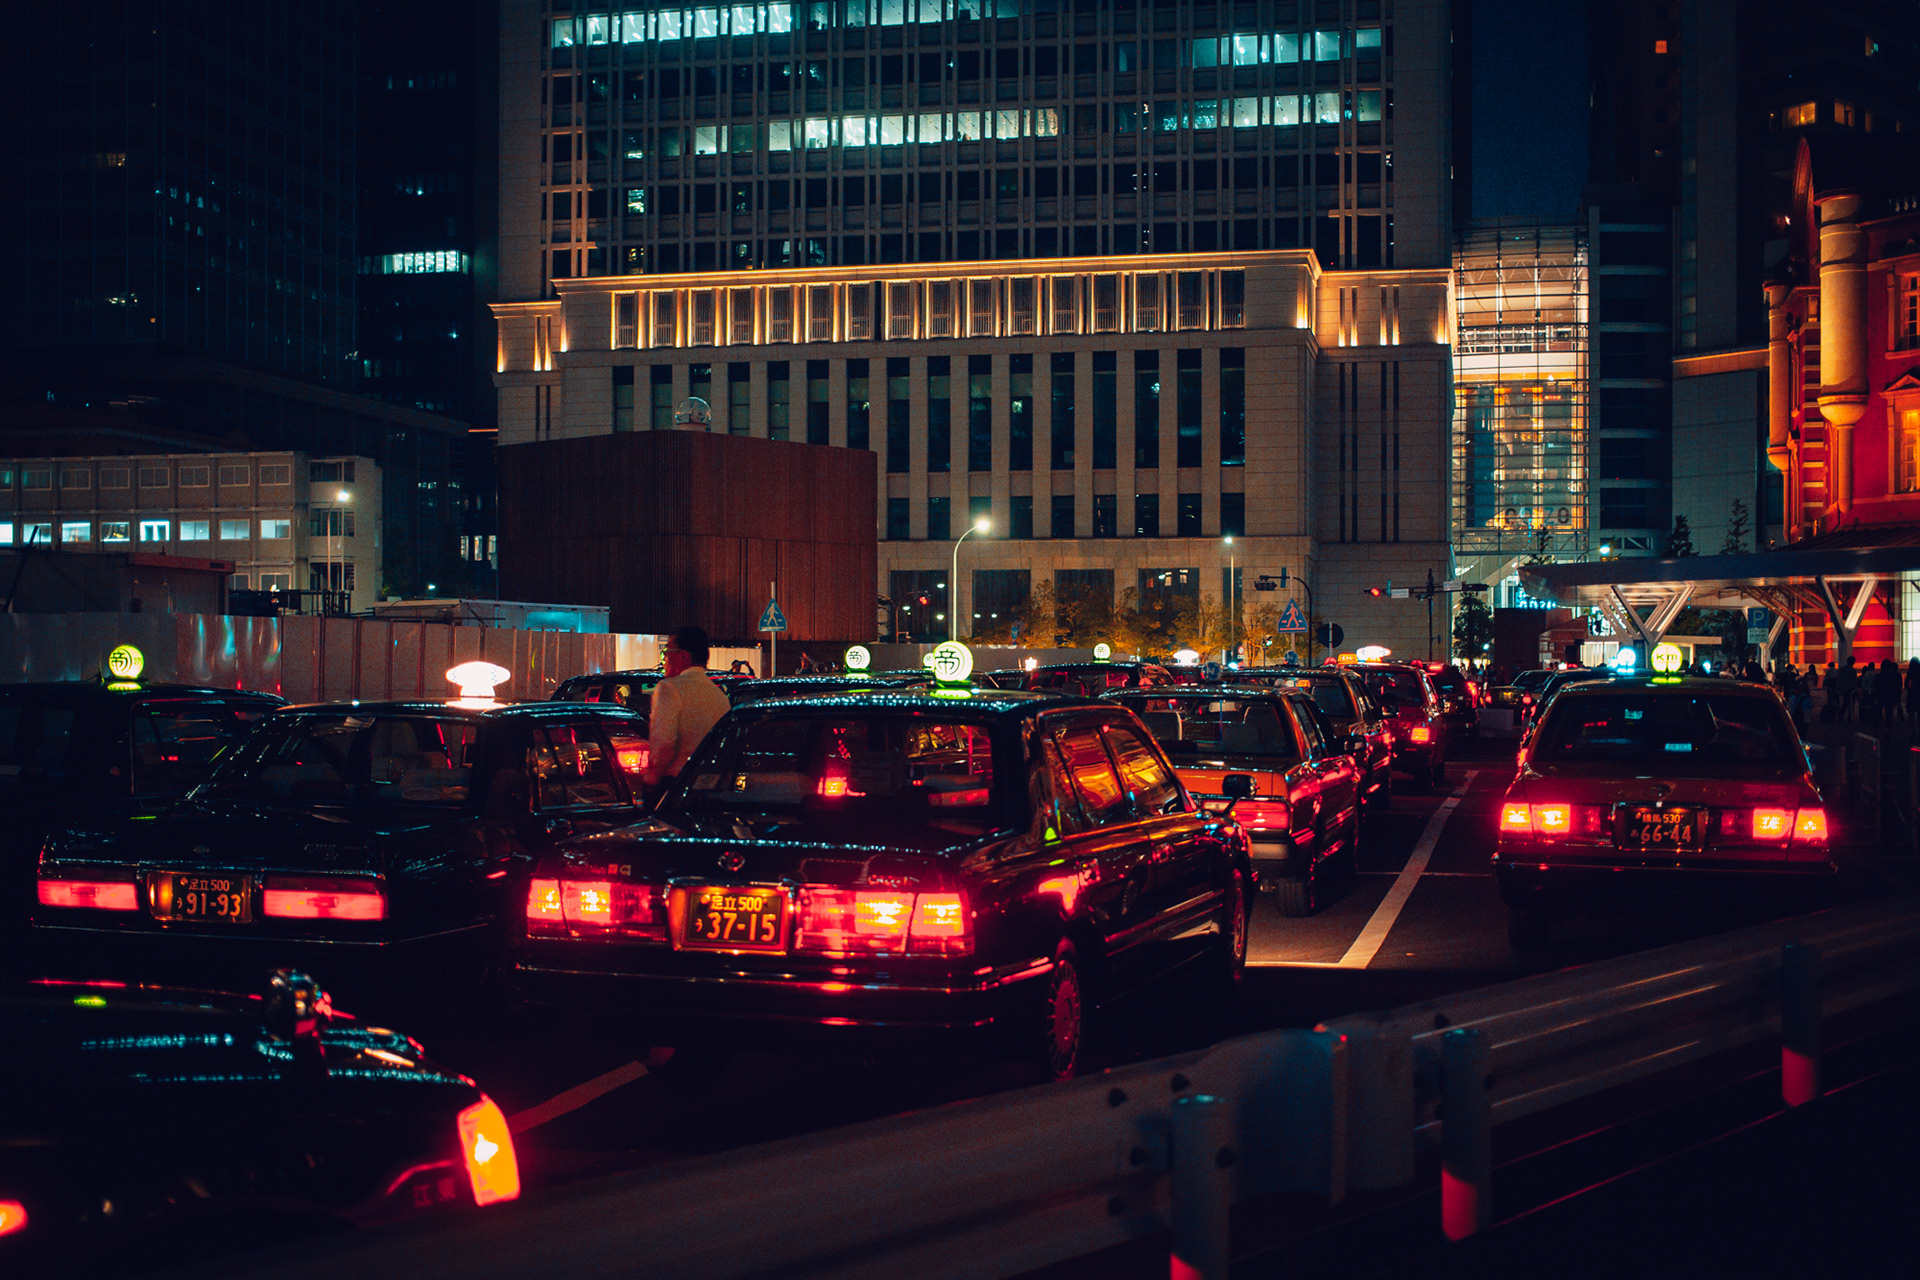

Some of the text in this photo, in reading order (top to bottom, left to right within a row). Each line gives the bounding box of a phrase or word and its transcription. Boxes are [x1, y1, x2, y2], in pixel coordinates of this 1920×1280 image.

[1753, 610, 1765, 627] P
[1662, 813, 1681, 824] 530
[1641, 824, 1692, 843] 66-44
[188, 878, 230, 892] 足立 500
[186, 892, 241, 917] 91-93
[710, 894, 764, 913] 足立 500
[706, 911, 777, 942] 37-15
